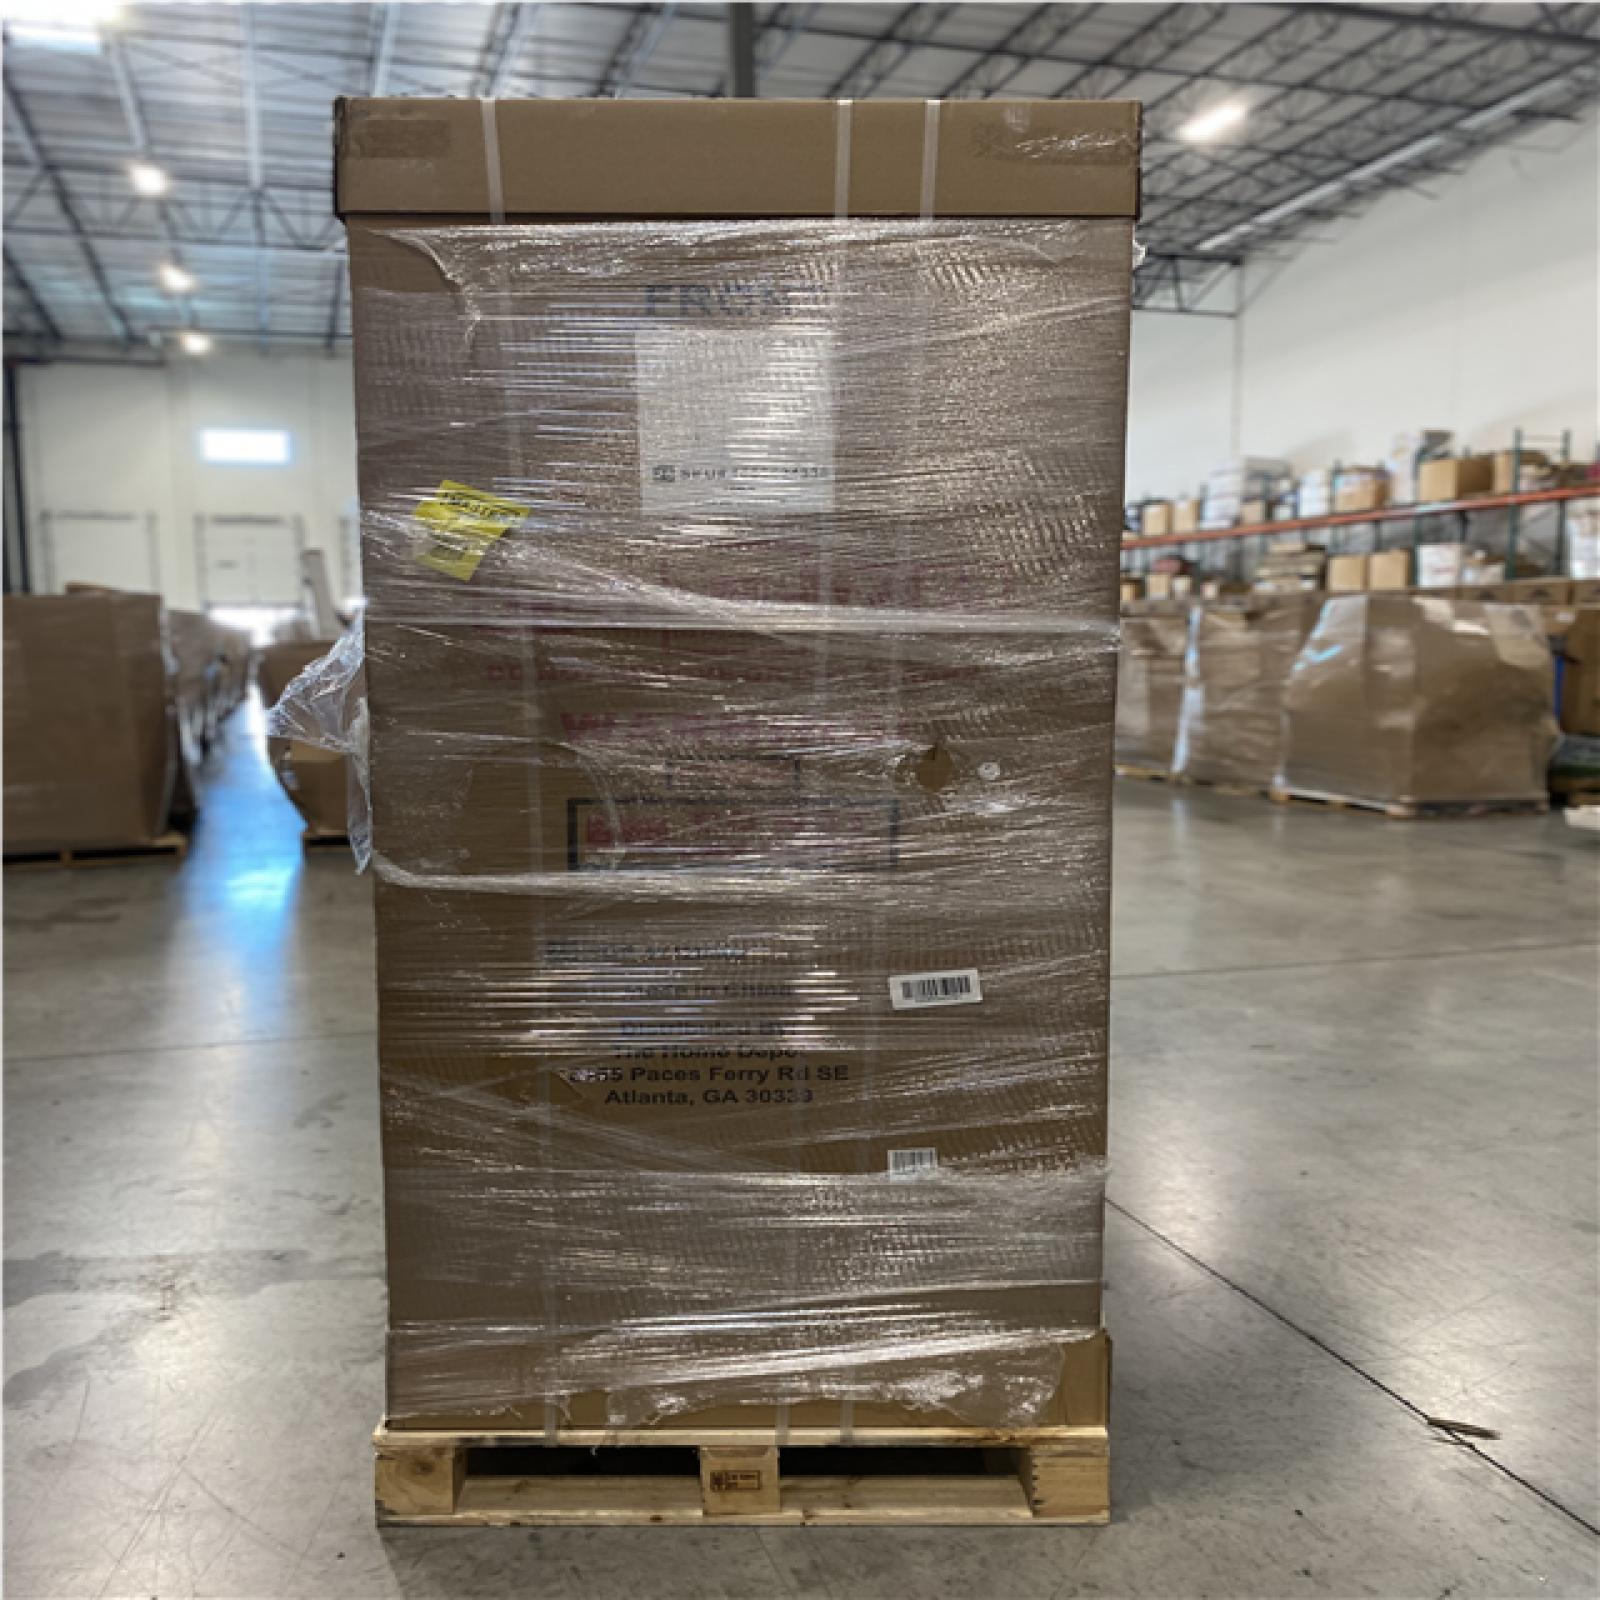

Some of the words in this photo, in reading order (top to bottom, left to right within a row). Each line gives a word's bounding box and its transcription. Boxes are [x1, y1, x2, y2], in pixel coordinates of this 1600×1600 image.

[630, 1066, 701, 1081] Paces
[709, 1066, 770, 1085] Ferry
[777, 1065, 809, 1081] Rd
[816, 1064, 849, 1081] SE
[604, 1089, 696, 1106] Atlanta,
[702, 1088, 739, 1103] GA
